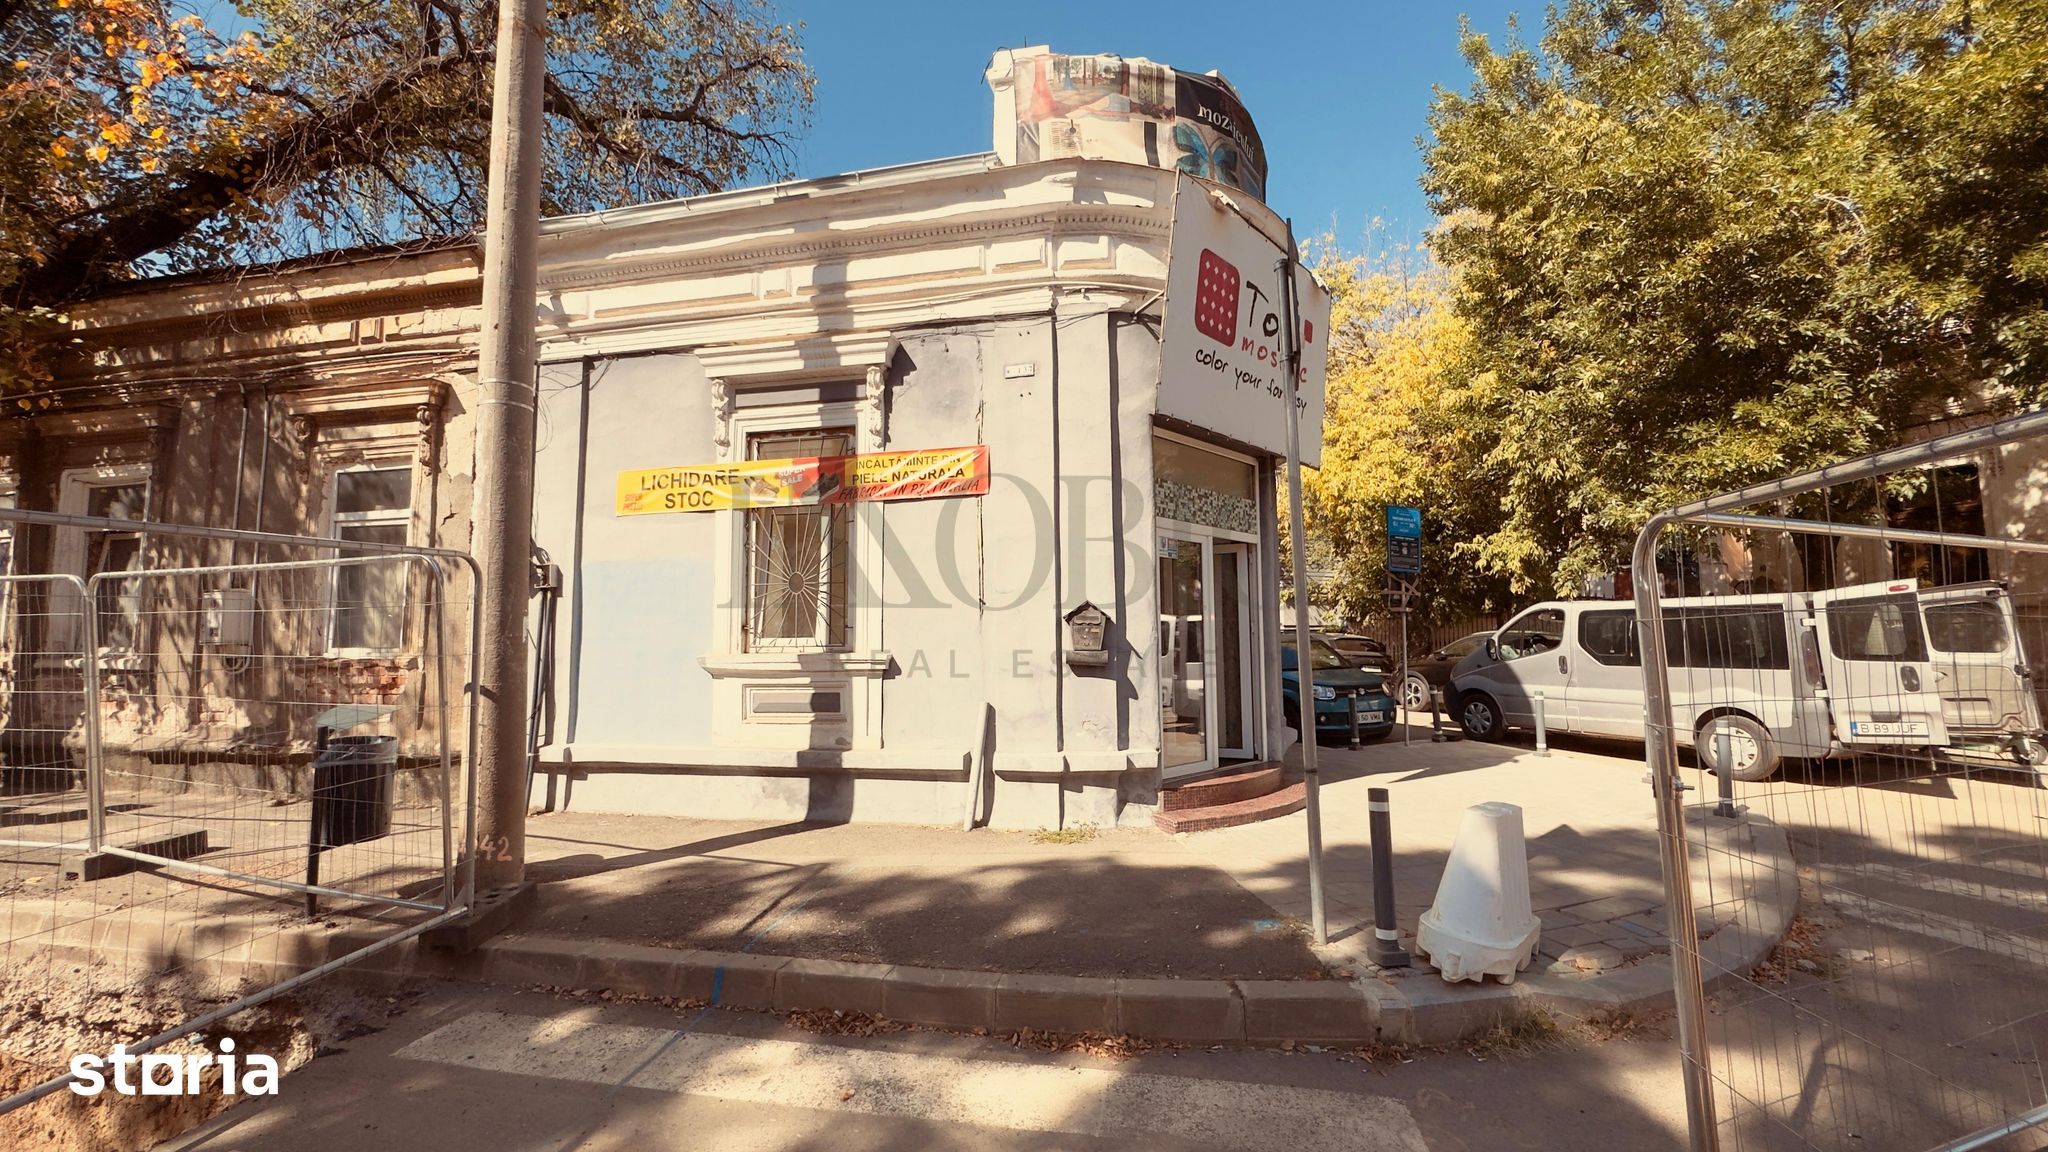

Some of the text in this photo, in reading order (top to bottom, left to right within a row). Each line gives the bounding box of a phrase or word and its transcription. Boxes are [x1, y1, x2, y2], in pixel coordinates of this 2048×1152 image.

[1195, 348, 1228, 373] color
[1235, 367, 1262, 390] your
[641, 468, 740, 491] LICHIDARE
[665, 490, 714, 509] STOC
[1860, 724, 1870, 733] B
